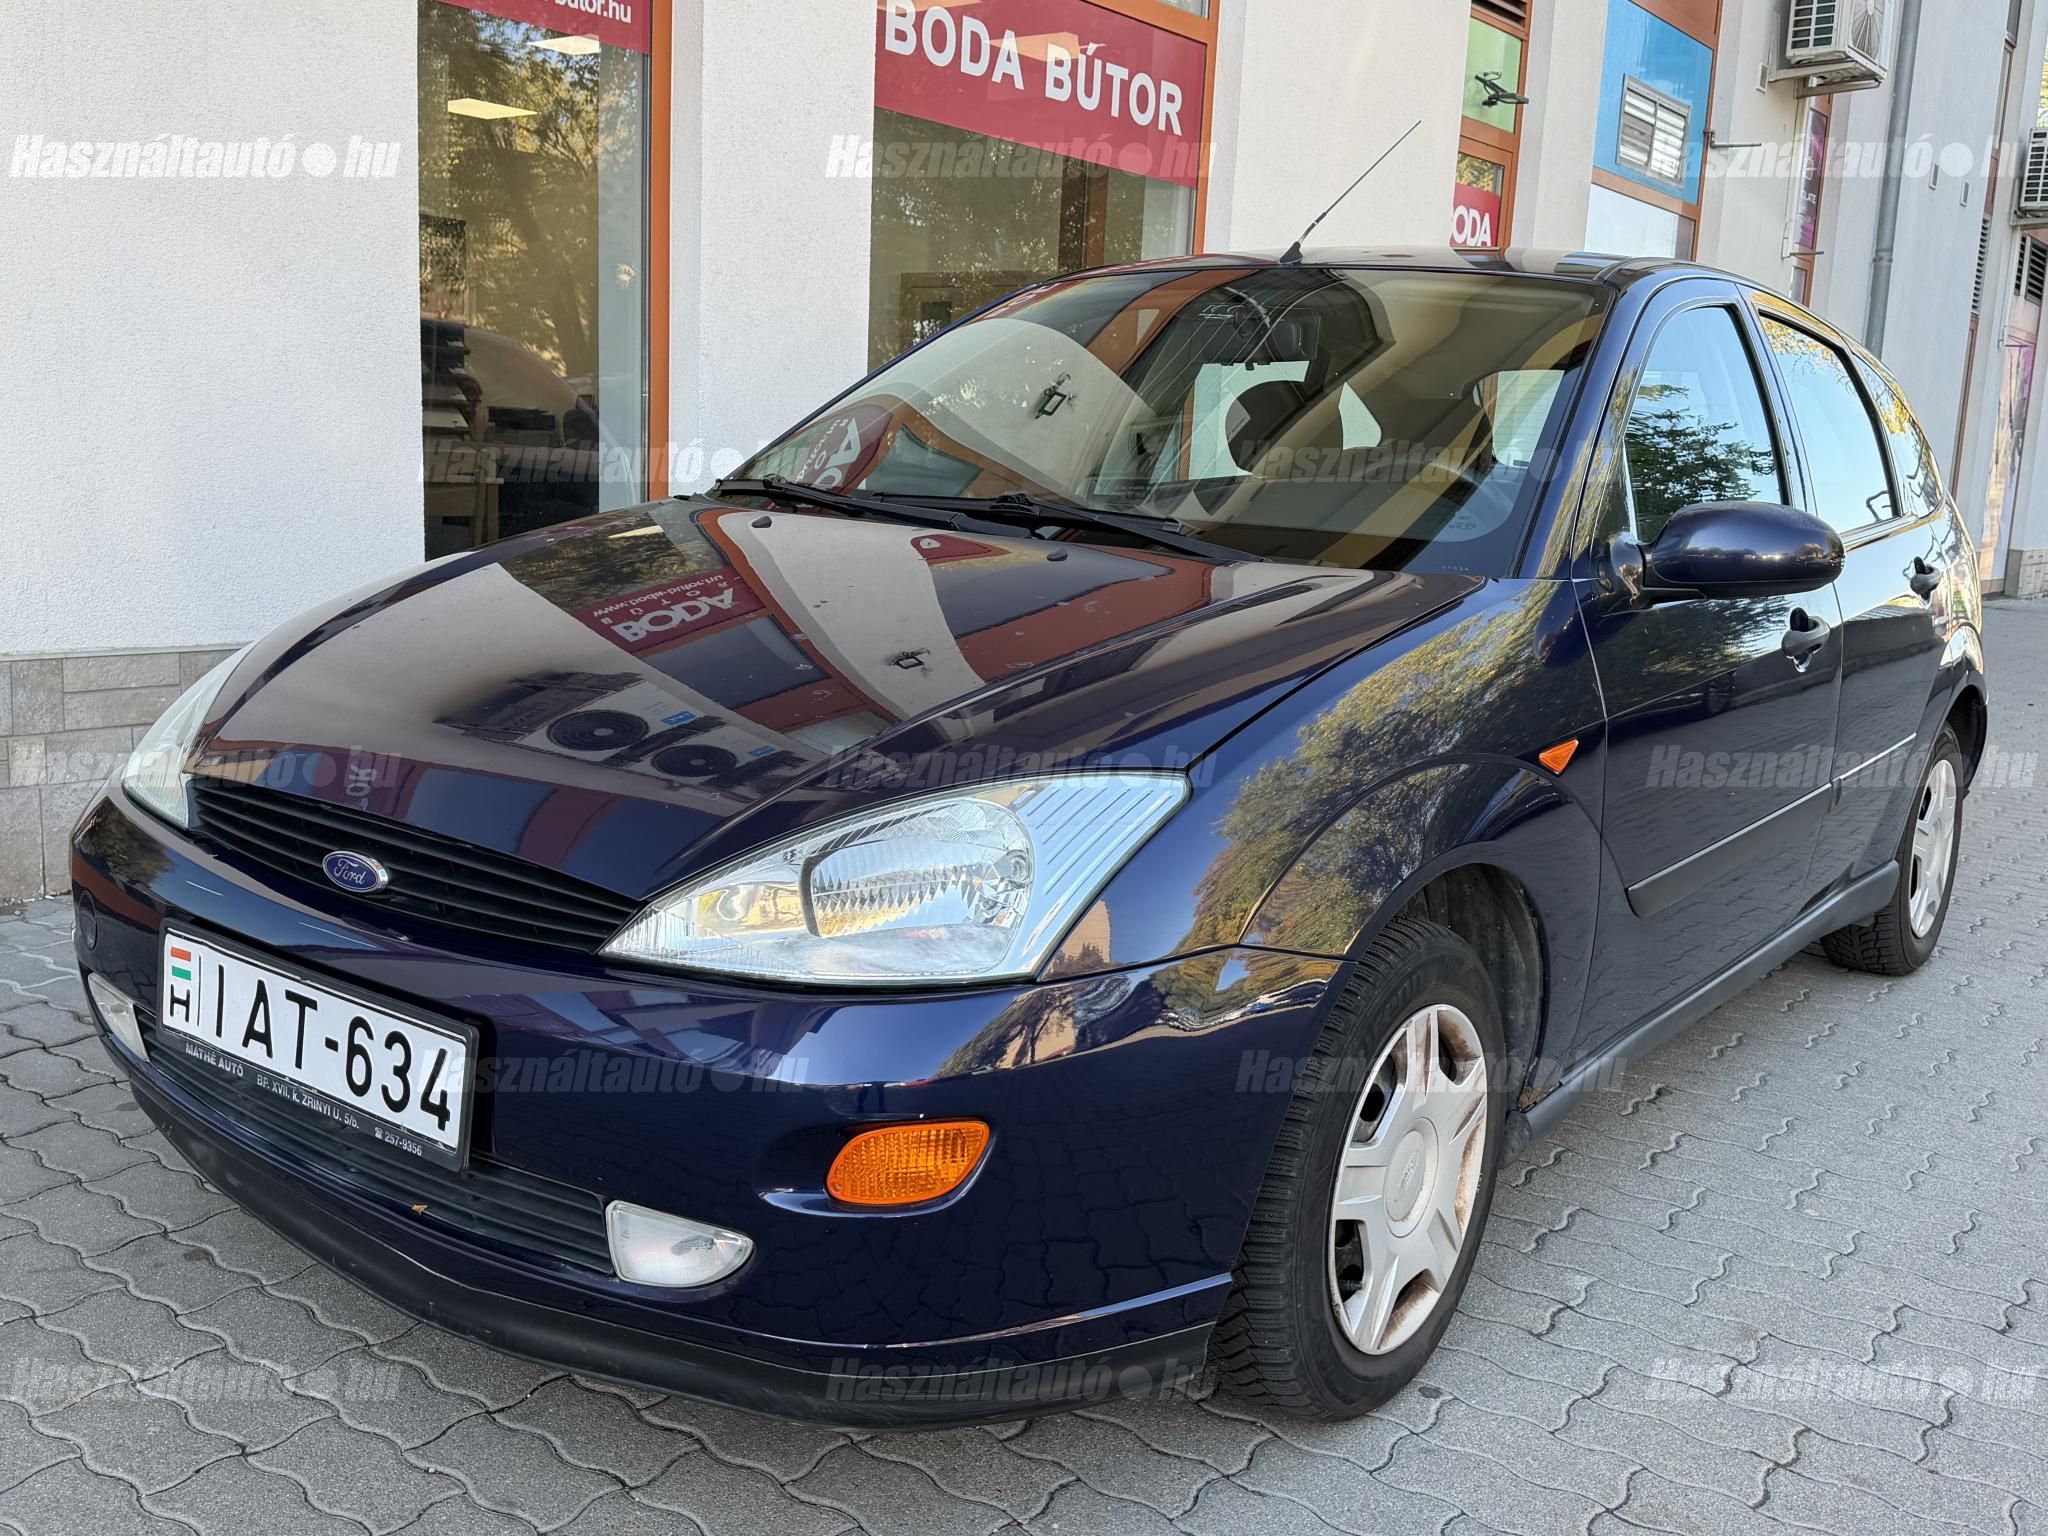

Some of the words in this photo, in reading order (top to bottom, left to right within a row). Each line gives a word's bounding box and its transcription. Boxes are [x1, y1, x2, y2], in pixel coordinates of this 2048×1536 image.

[885, 0, 1024, 90] BODA
[1045, 42, 1183, 136] BÚTOR
[1452, 204, 1492, 247] ODA
[333, 858, 367, 885] Ford
[215, 964, 451, 1131] IAT-634
[218, 1057, 244, 1077] AUTÓ
[384, 1131, 423, 1156] 257-9356
